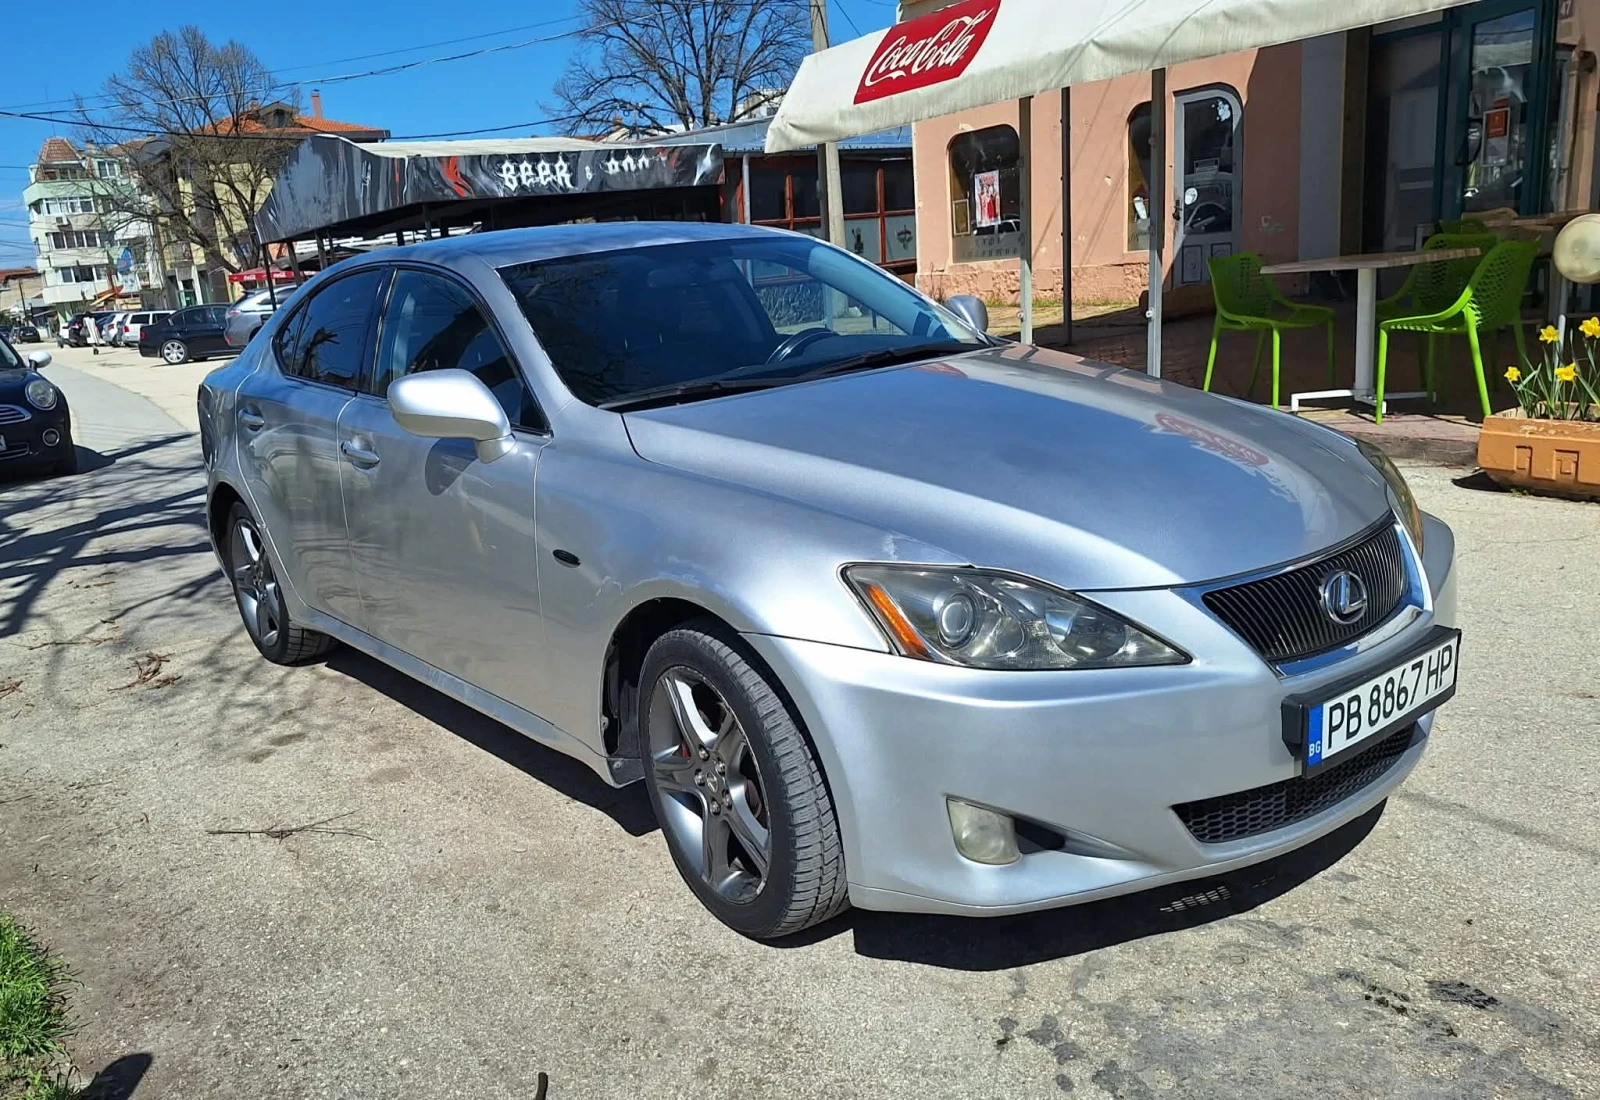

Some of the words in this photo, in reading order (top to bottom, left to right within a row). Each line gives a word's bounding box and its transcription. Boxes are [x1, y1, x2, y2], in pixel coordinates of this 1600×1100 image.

[865, 7, 994, 87] Coca-Cola
[1327, 694, 1362, 750] PB
[1367, 659, 1425, 728] 8867
[1425, 644, 1453, 696] HP
[1308, 740, 1321, 757] BG
